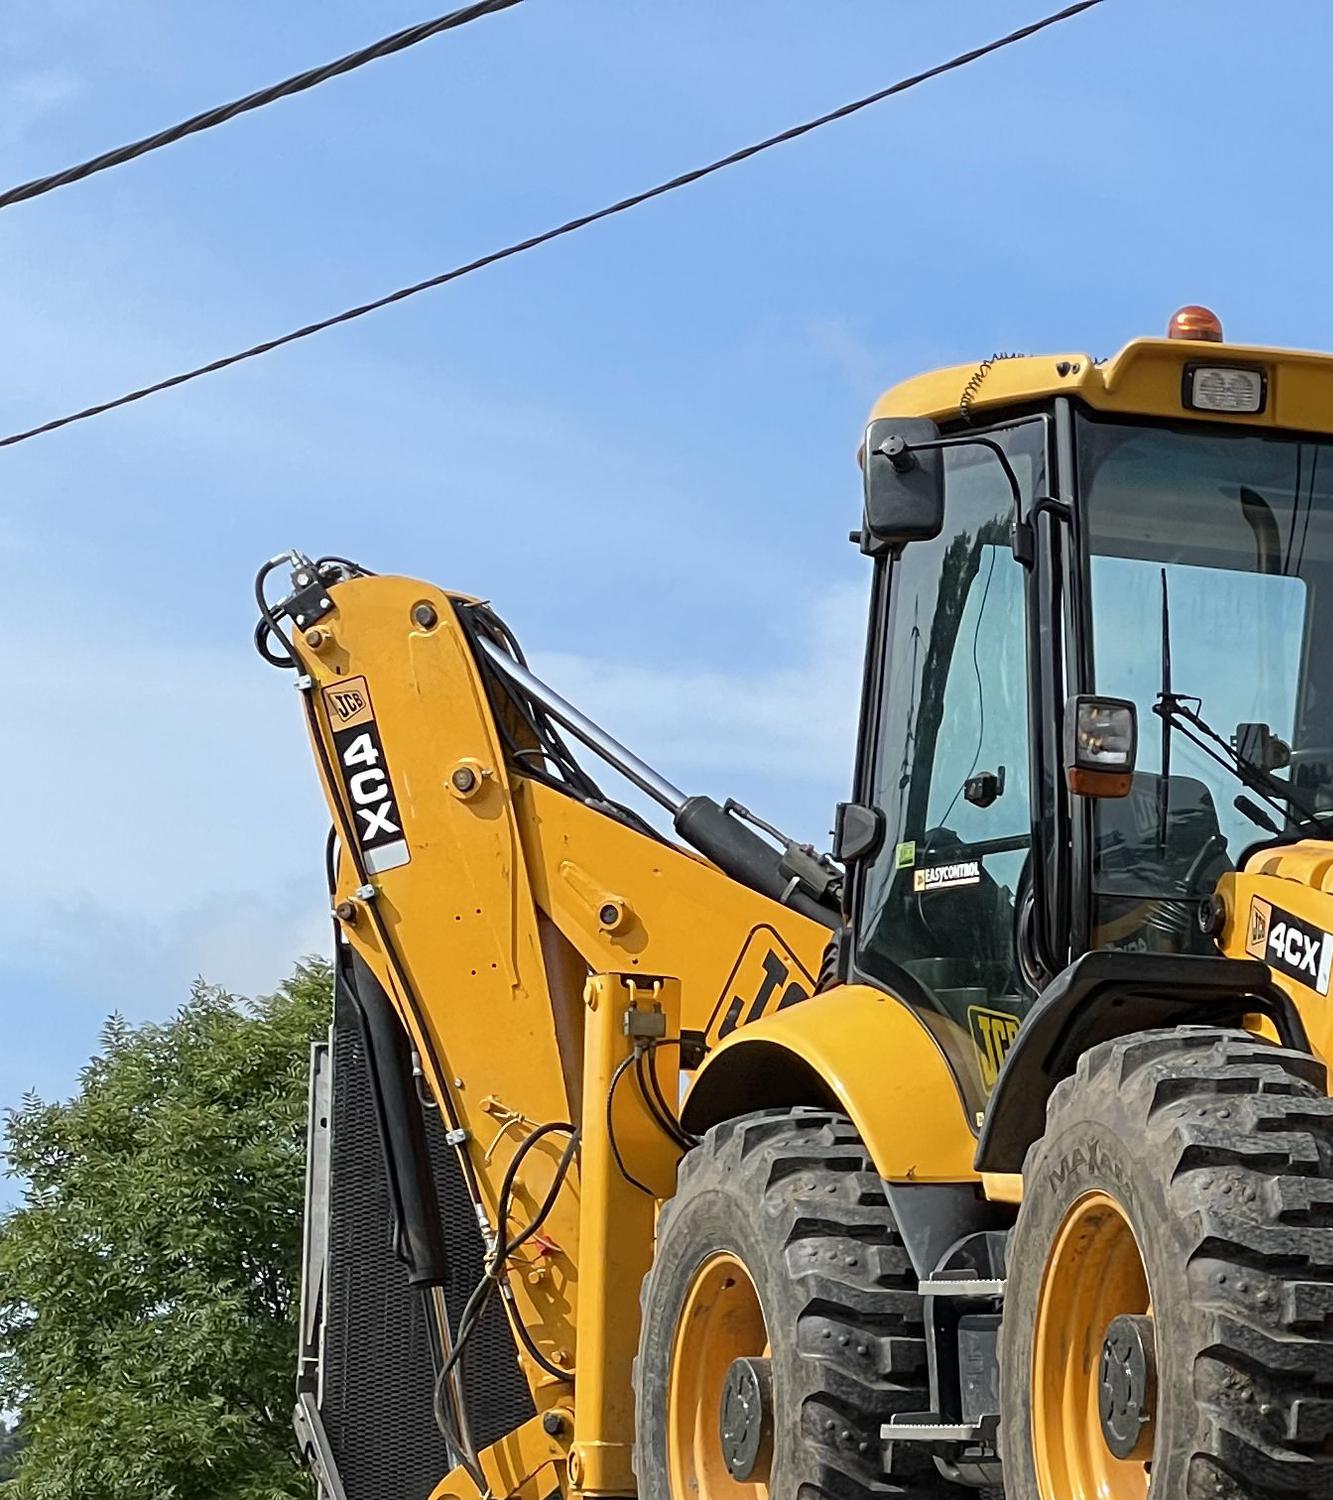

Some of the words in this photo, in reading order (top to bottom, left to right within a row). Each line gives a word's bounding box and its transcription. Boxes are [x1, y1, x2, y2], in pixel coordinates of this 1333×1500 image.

[334, 692, 364, 719] JCB
[342, 732, 401, 842] 4CX
[924, 861, 980, 884] EASYCONTROL
[1268, 921, 1321, 977] 4CX
